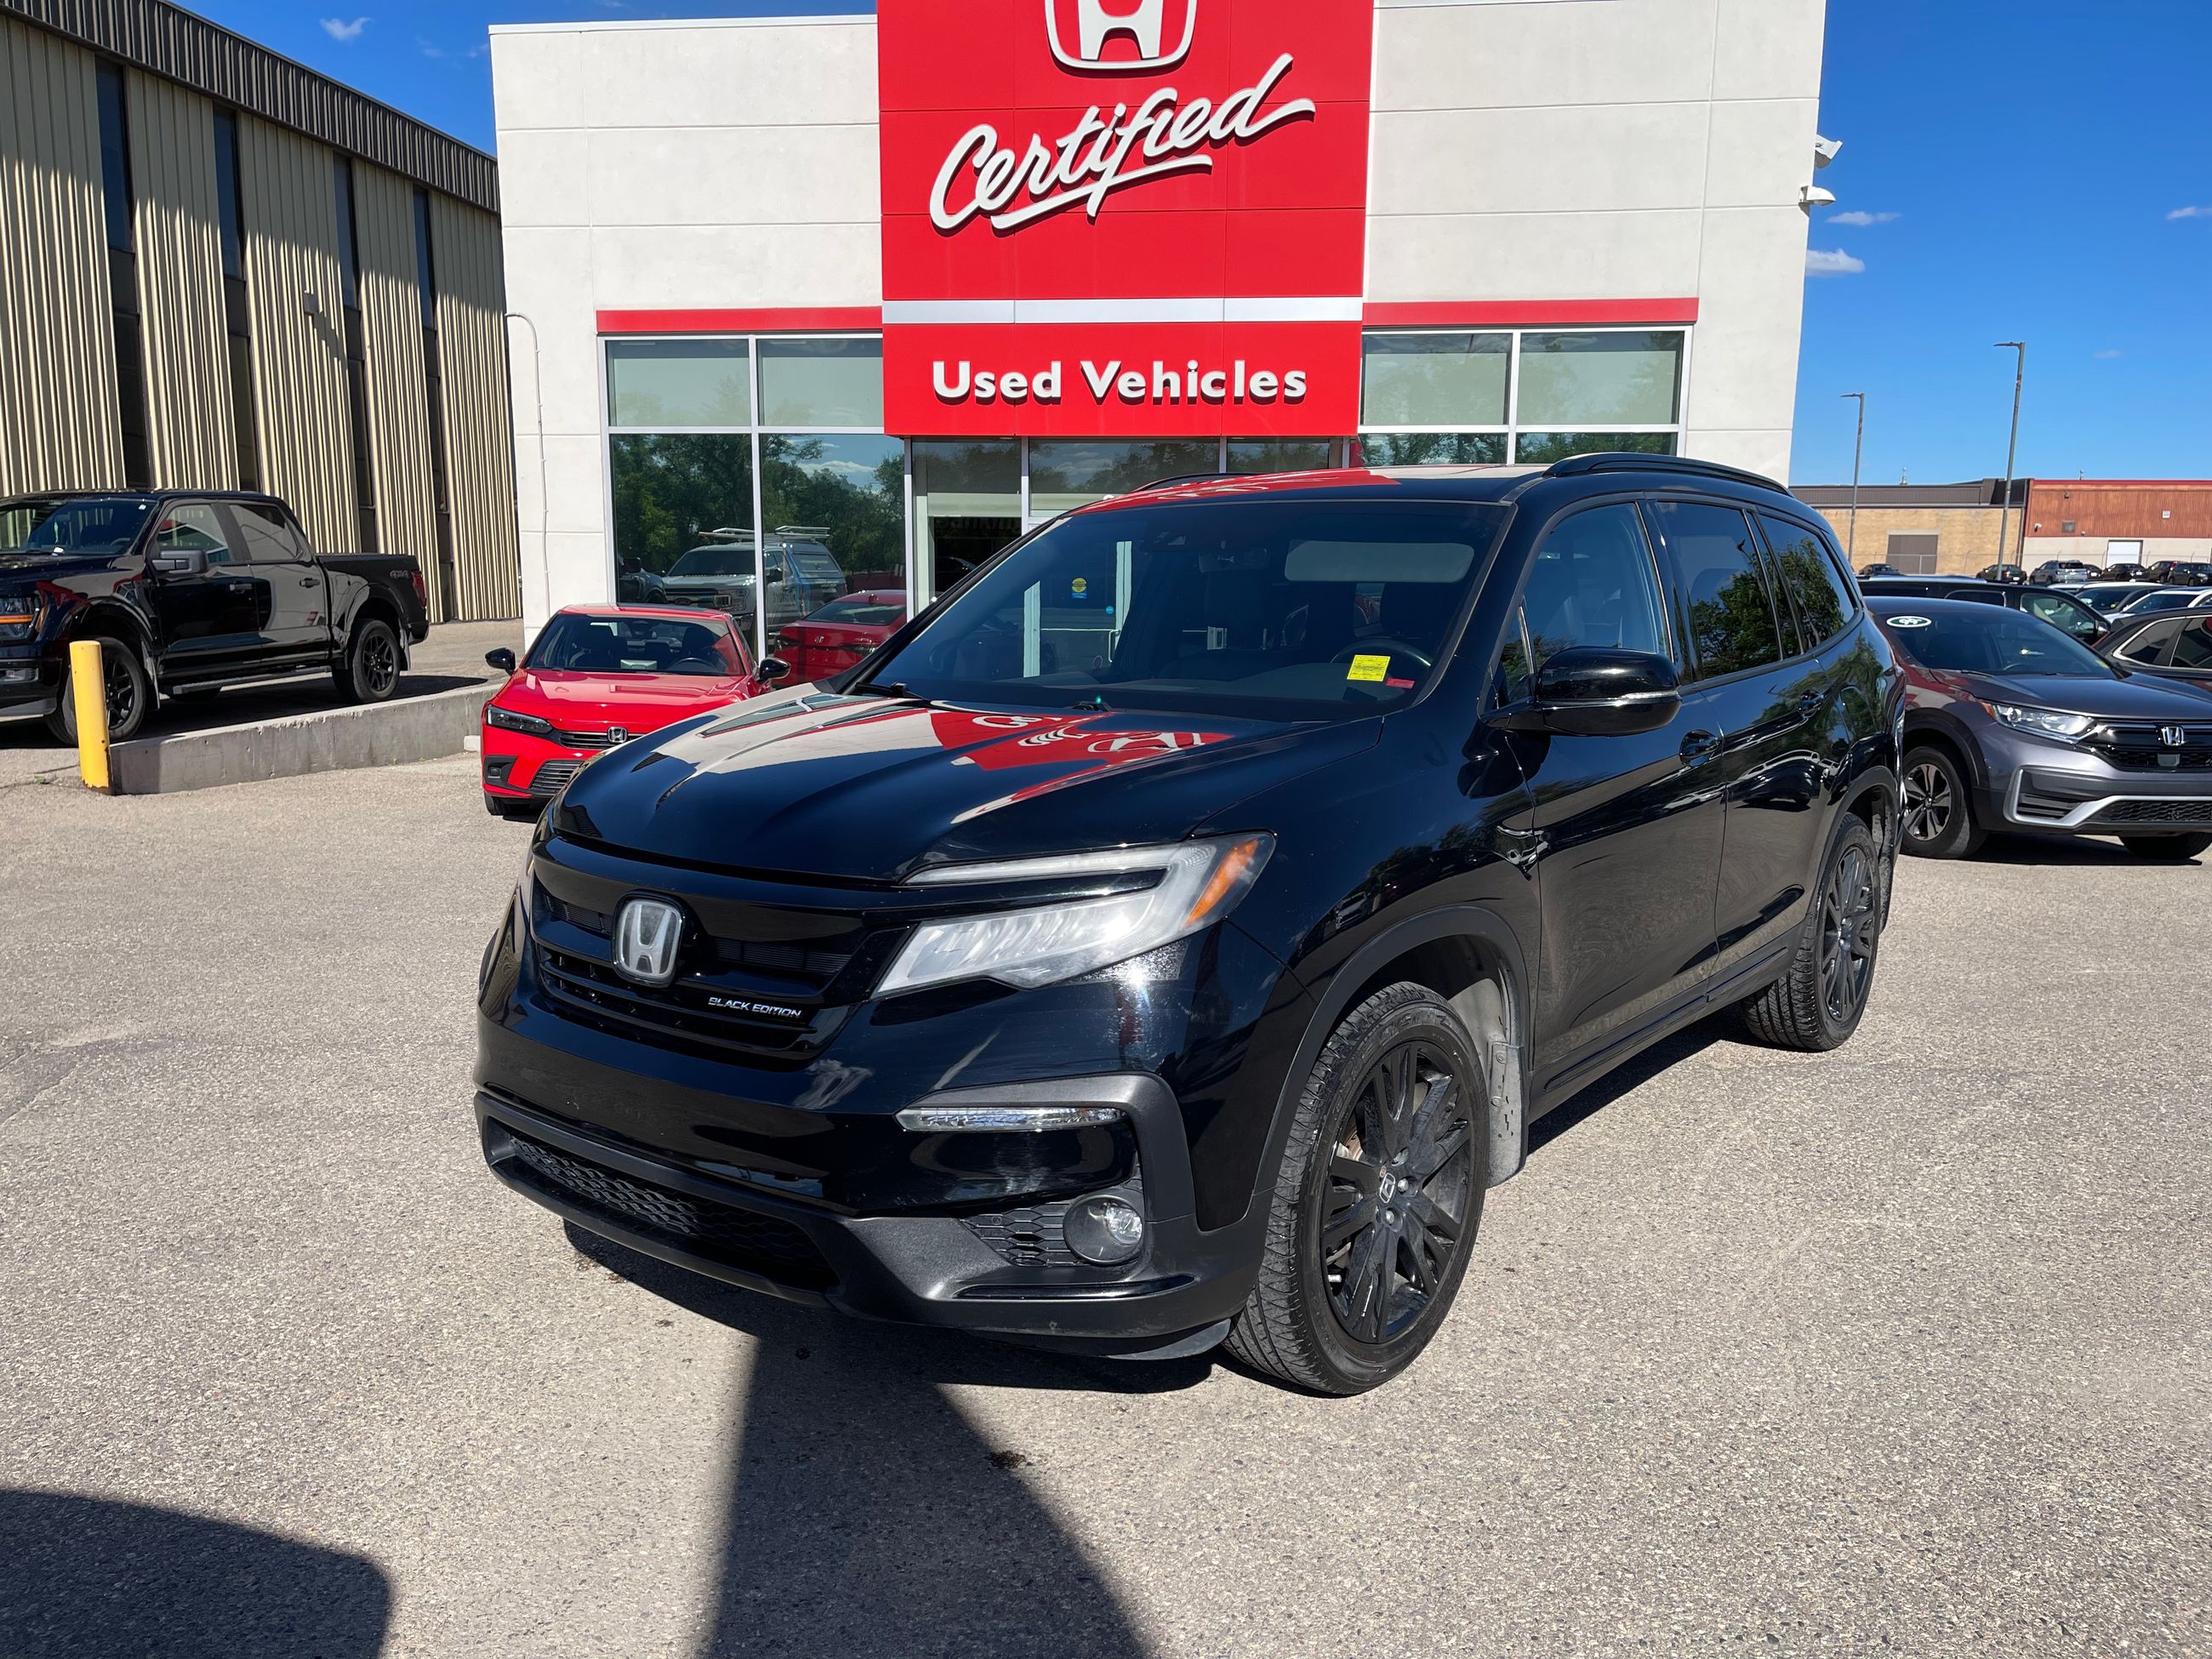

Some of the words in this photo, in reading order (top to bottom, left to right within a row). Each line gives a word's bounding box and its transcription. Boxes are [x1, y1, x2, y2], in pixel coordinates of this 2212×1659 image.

[929, 53, 1316, 229] Certified
[932, 361, 1062, 400] Used
[1080, 360, 1308, 400] Vehicles
[708, 996, 750, 1011] BLACK
[751, 1004, 802, 1018] EDITION
